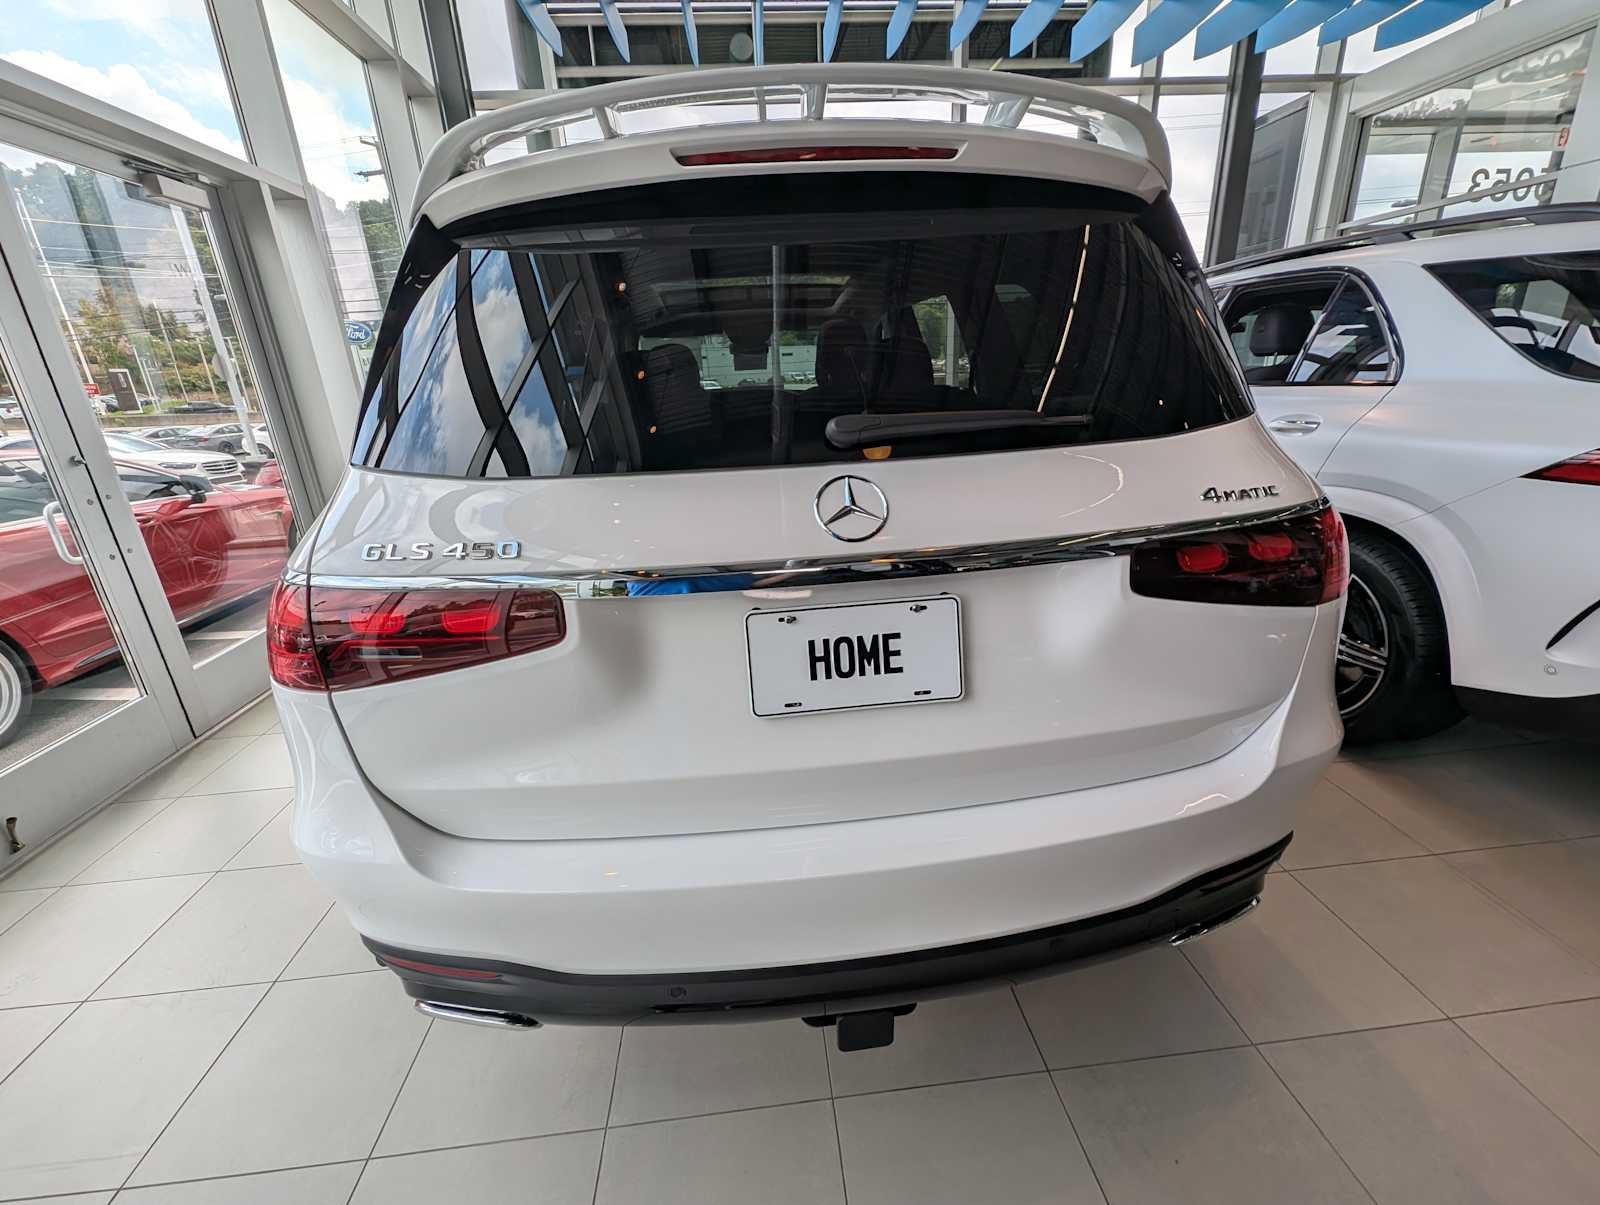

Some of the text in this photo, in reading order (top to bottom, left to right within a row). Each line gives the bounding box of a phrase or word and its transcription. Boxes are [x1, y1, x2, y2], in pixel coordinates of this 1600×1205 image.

[345, 324, 366, 340] Ford
[1199, 484, 1280, 504] 4MATIC
[361, 541, 522, 562] GLS 450
[808, 632, 904, 680] HOME
